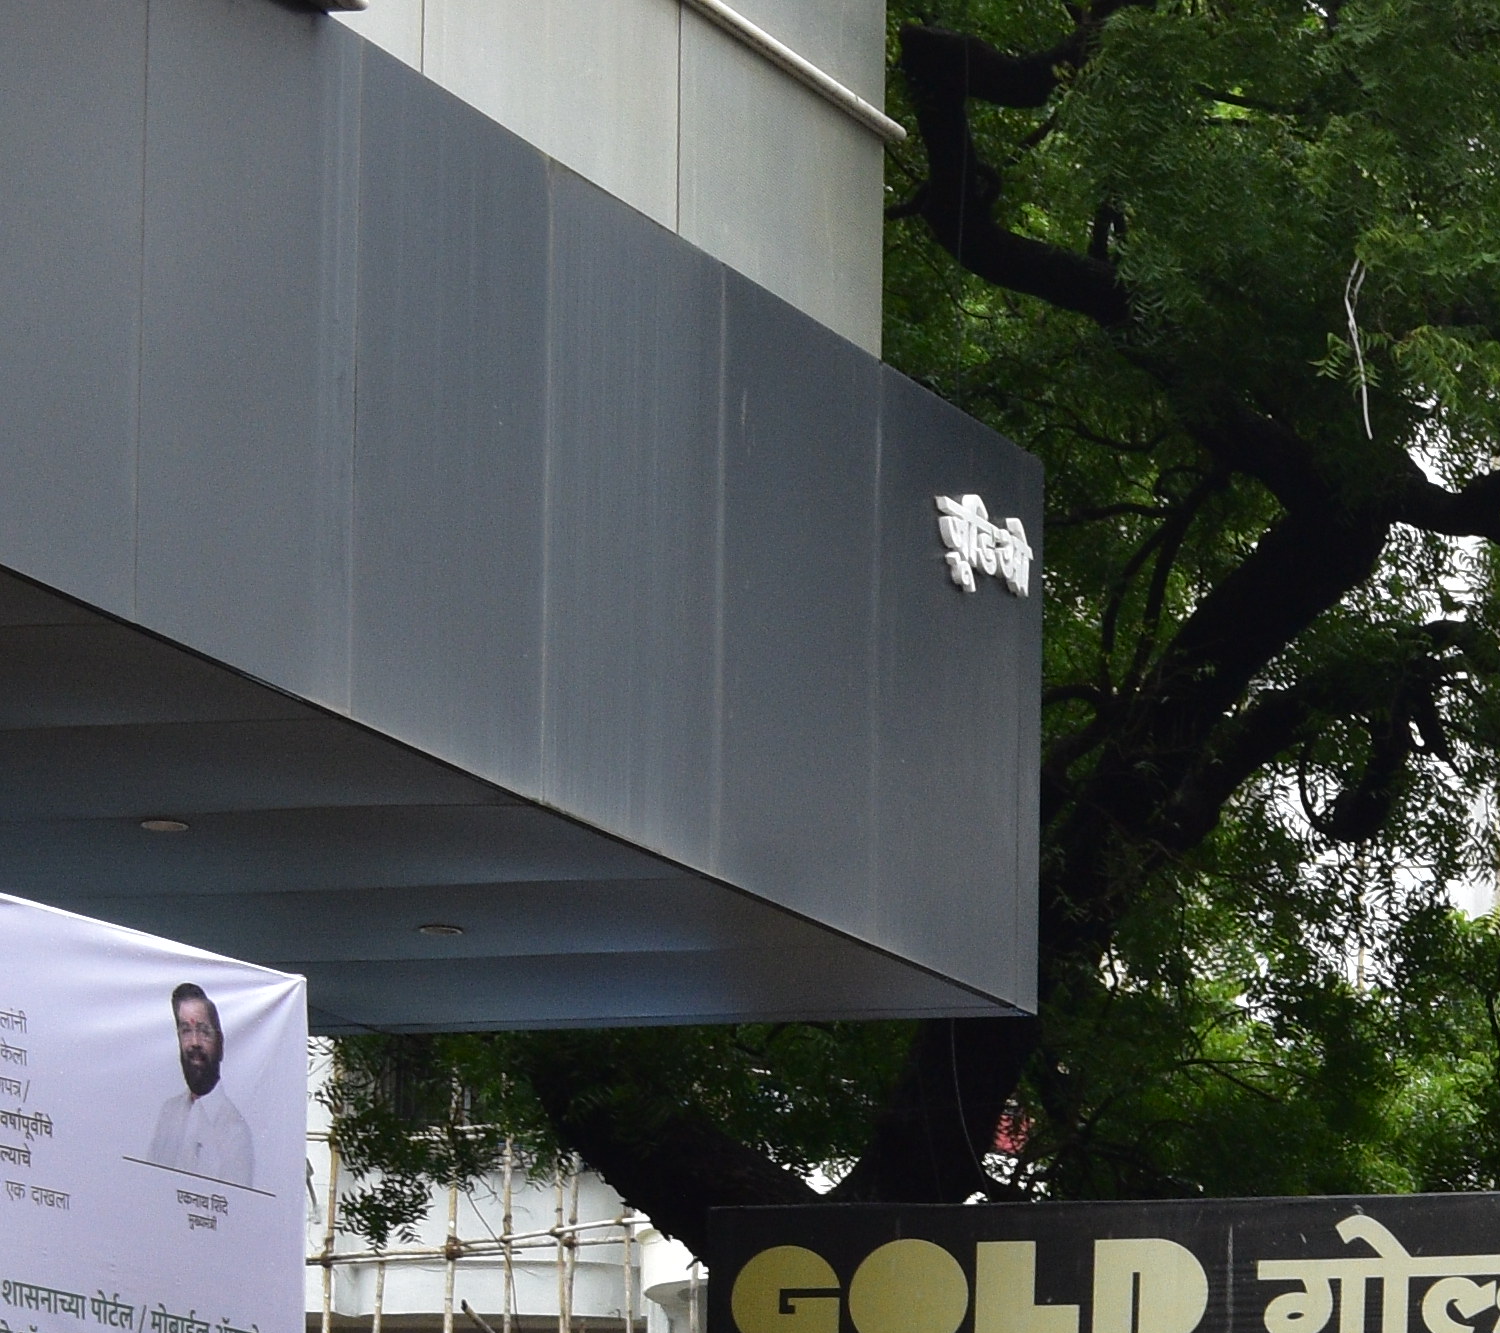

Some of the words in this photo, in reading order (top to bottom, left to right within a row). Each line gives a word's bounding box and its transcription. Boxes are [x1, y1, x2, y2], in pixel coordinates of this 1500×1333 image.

[30, 1185, 70, 1211] दाखला
[2, 1279, 86, 1320] शासनाच्या
[91, 1289, 133, 1330] पोर्टल
